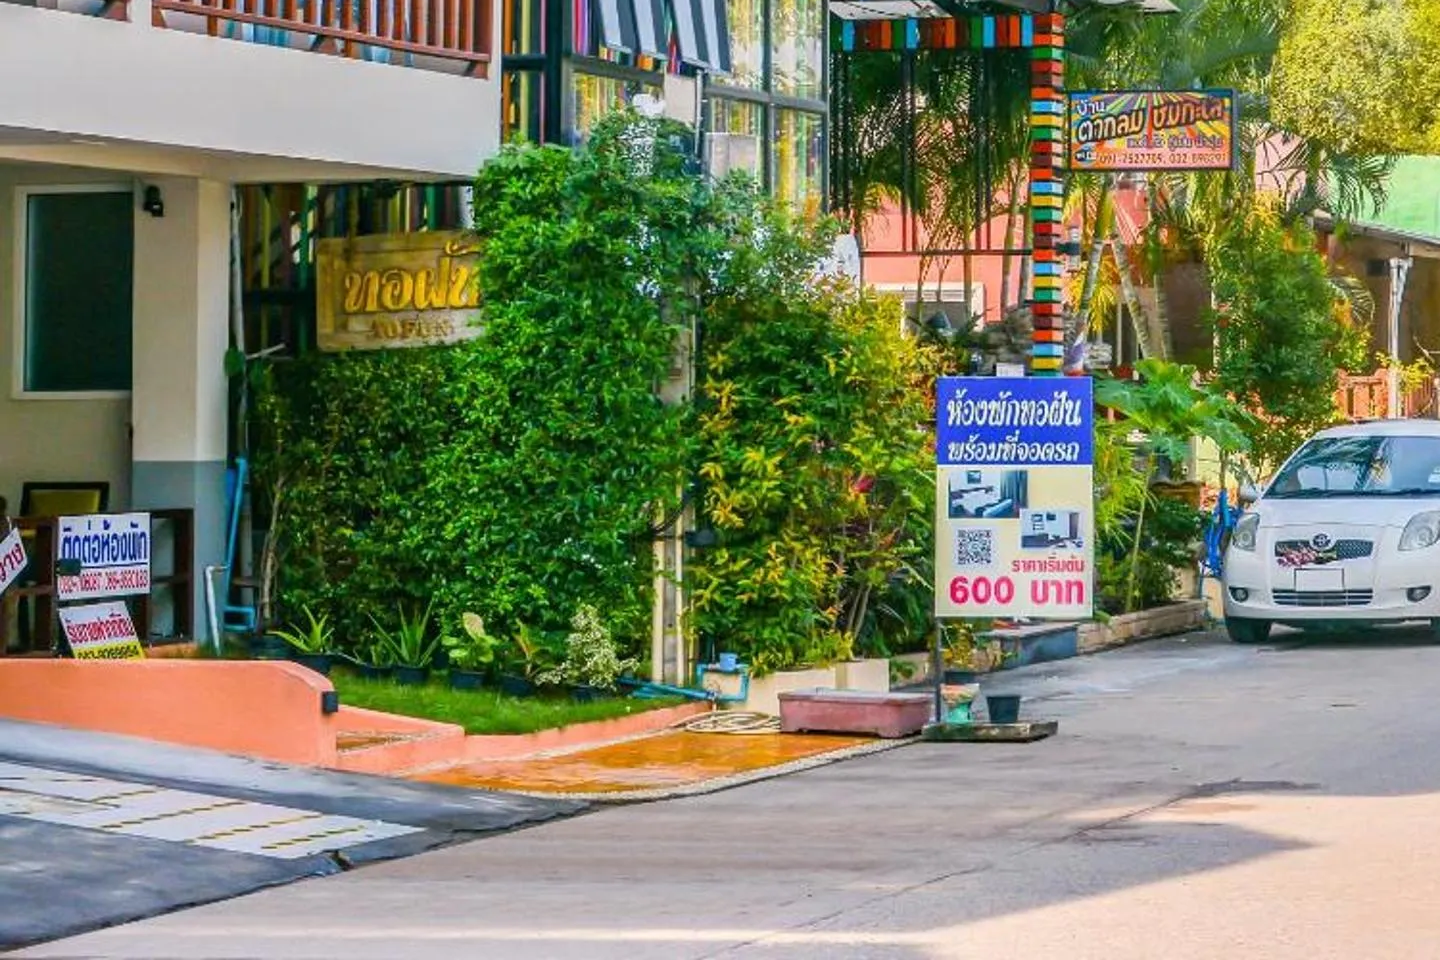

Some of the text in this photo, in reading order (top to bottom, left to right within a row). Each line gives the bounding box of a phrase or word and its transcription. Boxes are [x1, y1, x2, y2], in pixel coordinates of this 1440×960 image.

[947, 389, 1082, 428] ห้องพักทอฝัน
[948, 431, 1079, 462] พร้อมที่จอดรถ
[1011, 553, 1084, 573] ราคาเริ่มต้น
[949, 576, 1084, 606] 600 บาท
